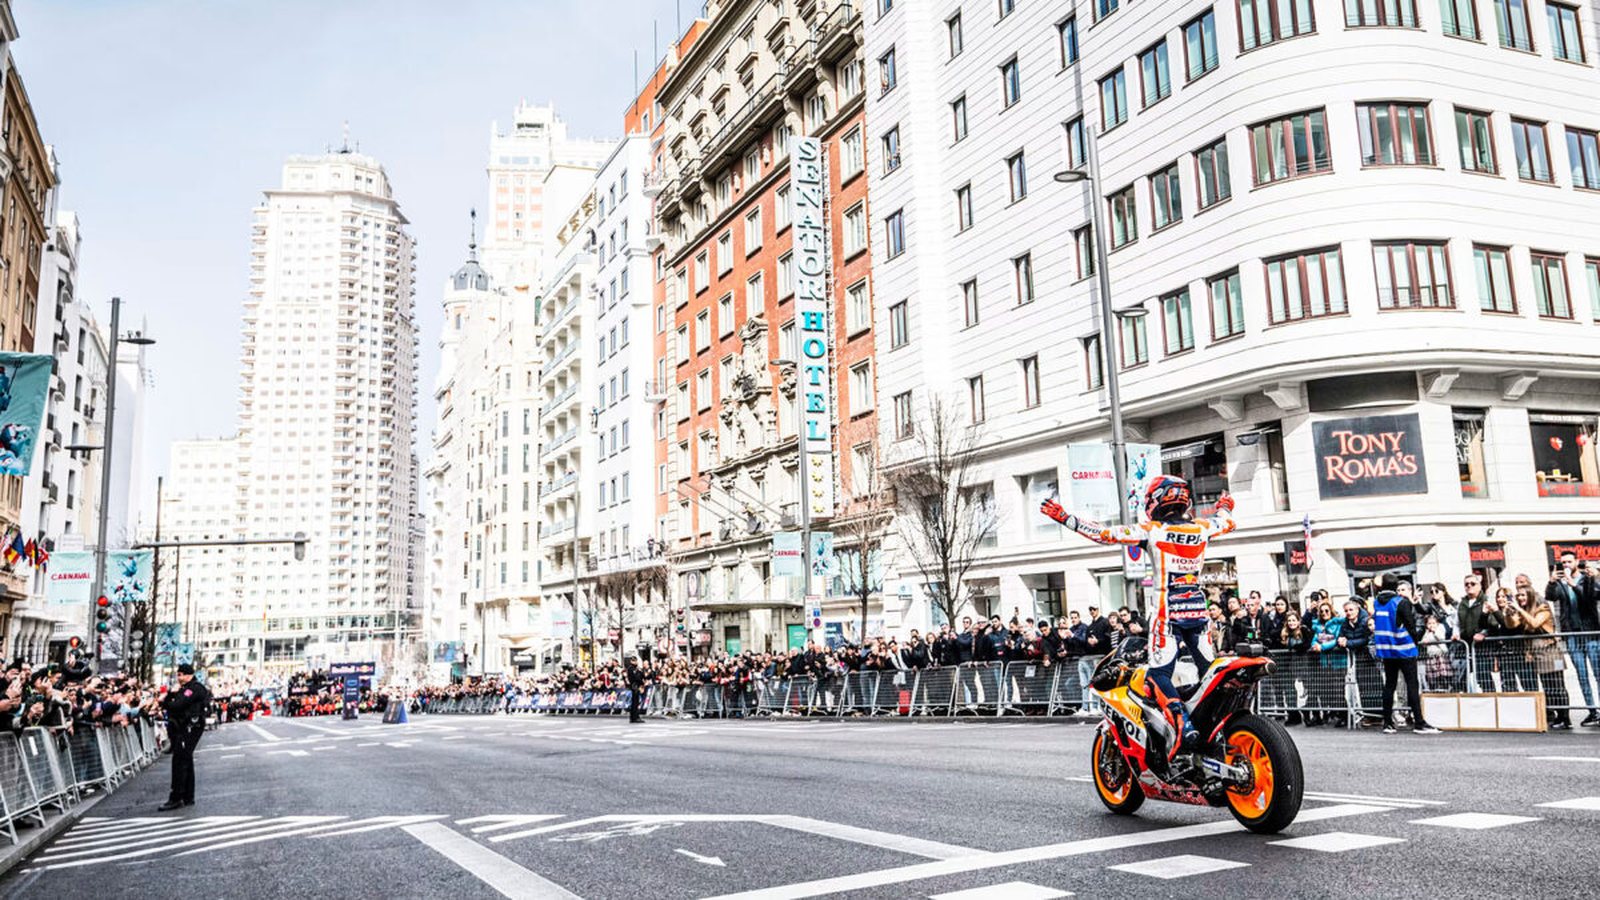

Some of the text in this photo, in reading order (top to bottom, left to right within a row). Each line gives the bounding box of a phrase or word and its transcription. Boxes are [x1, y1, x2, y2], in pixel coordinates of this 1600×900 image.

[797, 141, 828, 441] SENATOR HOTEL
[1331, 430, 1406, 456] TONY
[1323, 451, 1419, 485] ROMA'S
